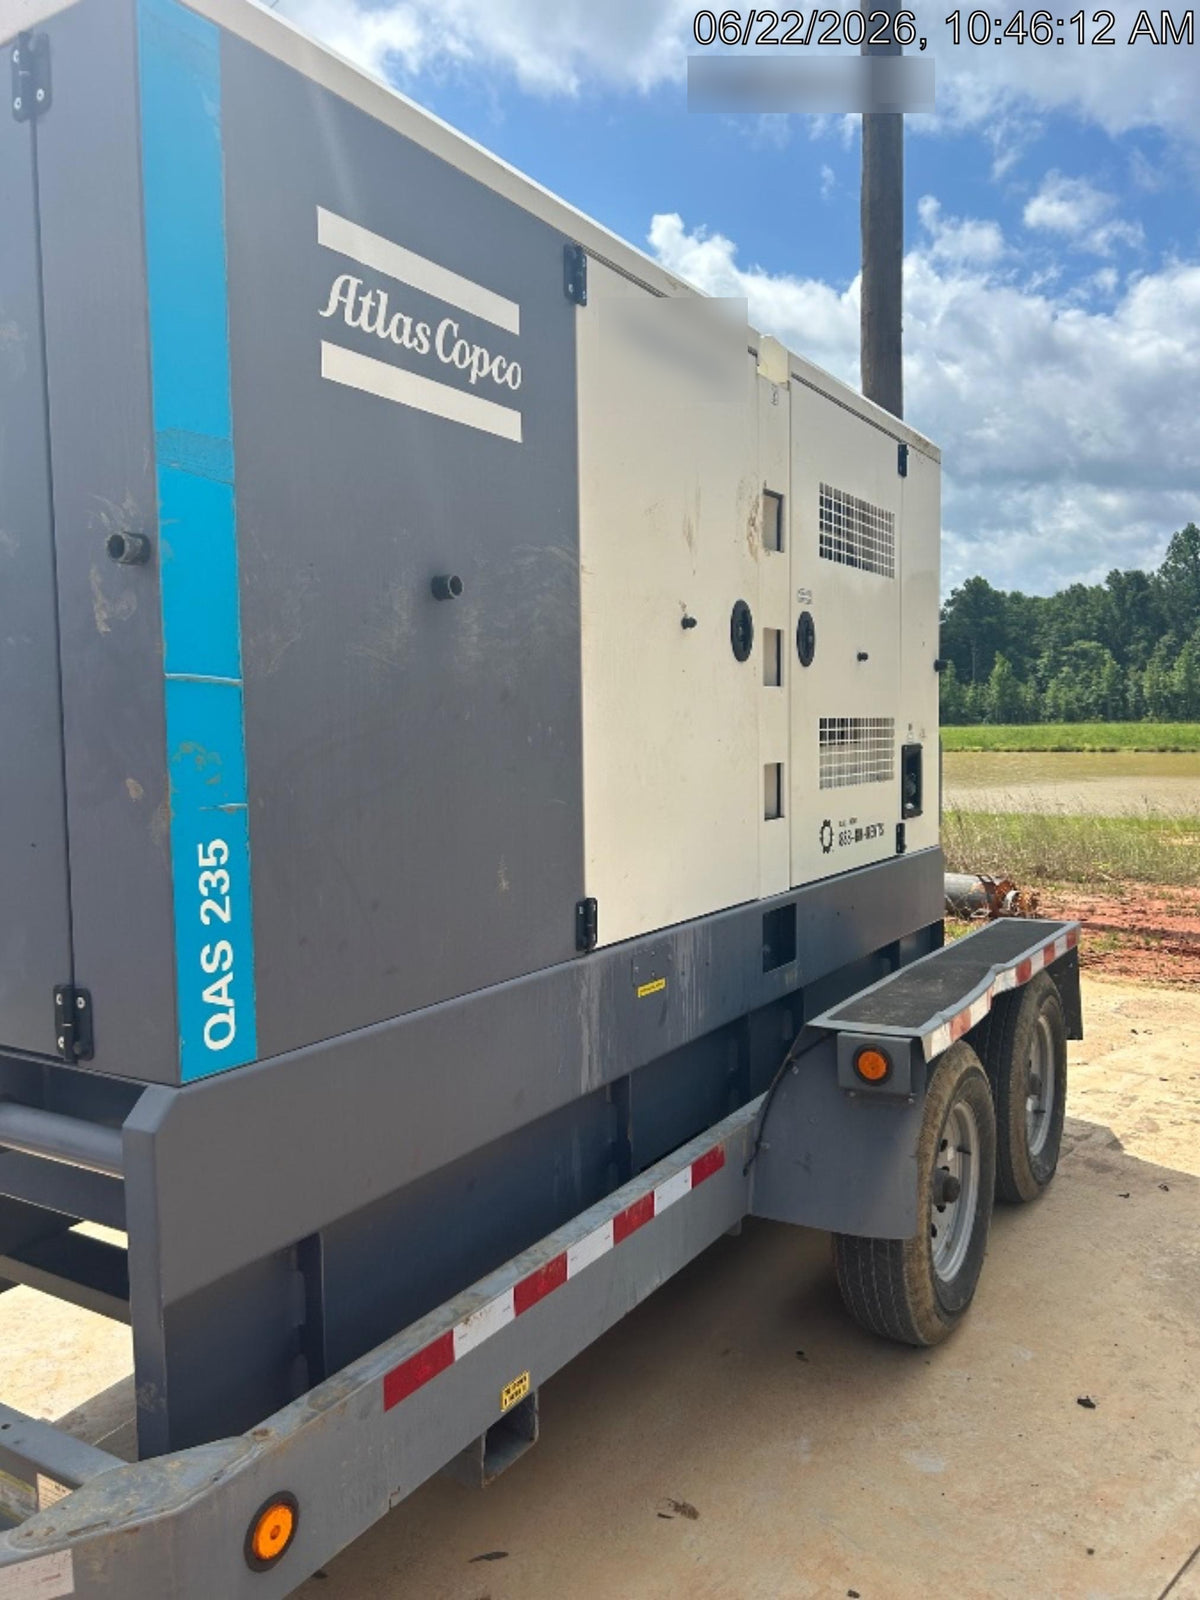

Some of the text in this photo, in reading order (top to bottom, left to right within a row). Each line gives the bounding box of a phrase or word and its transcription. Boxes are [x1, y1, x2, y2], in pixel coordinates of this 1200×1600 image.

[318, 274, 522, 390] Atlas Copco
[197, 838, 236, 1051] QAS 235
